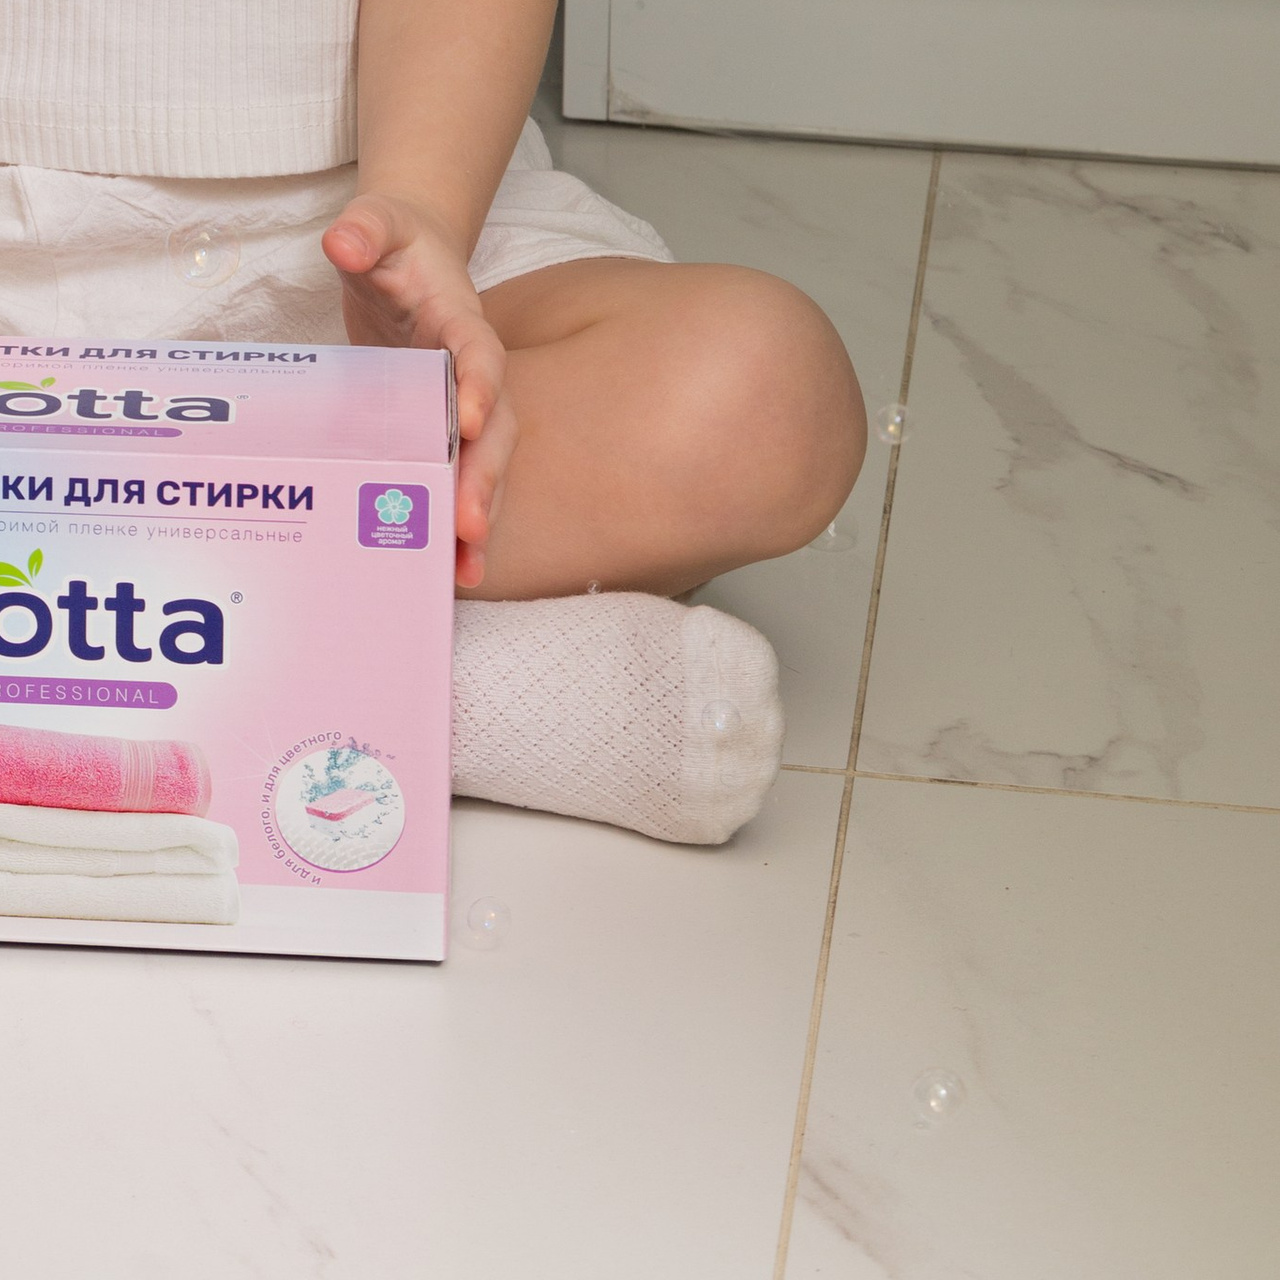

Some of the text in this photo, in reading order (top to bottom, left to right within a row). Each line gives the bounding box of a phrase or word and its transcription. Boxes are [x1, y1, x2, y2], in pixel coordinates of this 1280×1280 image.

[79, 347, 158, 360] ДЛЯ
[167, 349, 318, 363] СТИРКИ
[82, 363, 150, 372] пленке
[158, 366, 307, 376] универсальные
[64, 478, 145, 507] ДЛЯ
[156, 480, 315, 511] СТИРКИ
[68, 521, 139, 537] пленке
[147, 524, 304, 544] универсальные
[376, 525, 408, 533] нежный
[279, 731, 342, 766] цветного
[264, 766, 282, 792] для
[261, 794, 270, 803] и
[284, 858, 311, 880] для
[311, 875, 322, 885] и
